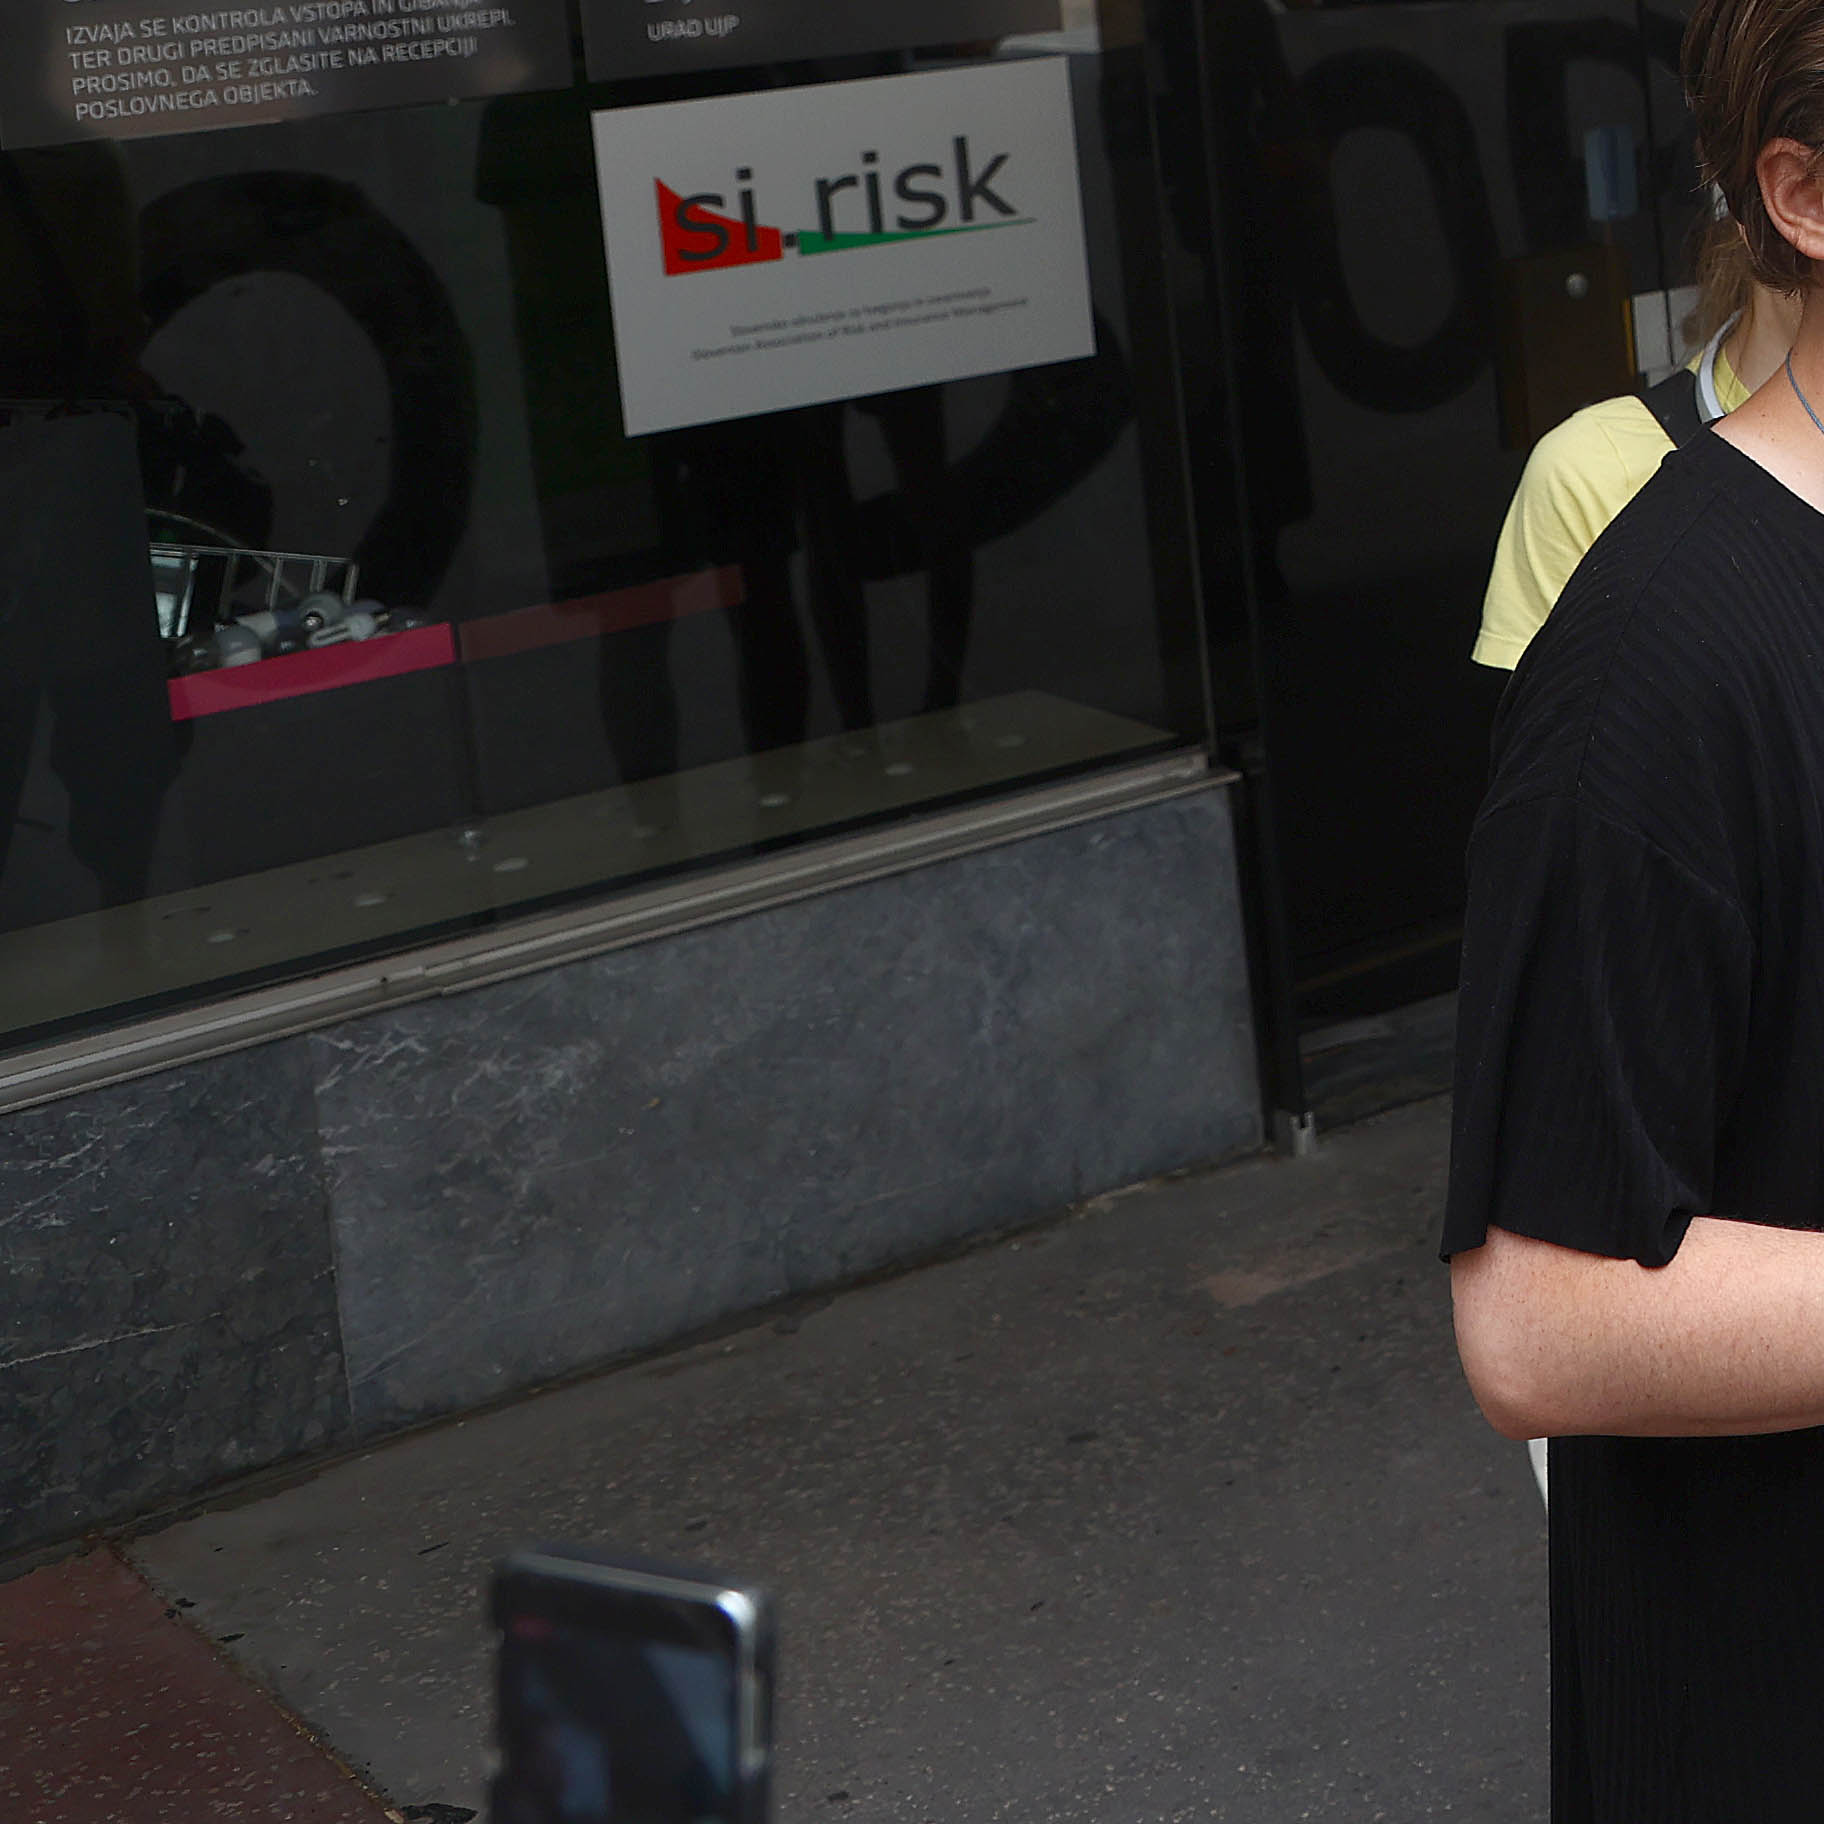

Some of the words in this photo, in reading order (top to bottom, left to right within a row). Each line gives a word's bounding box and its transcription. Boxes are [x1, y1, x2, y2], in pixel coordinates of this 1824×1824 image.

[66, 21, 136, 46] IZVAJA
[140, 18, 168, 39] SE
[172, 6, 286, 36] KONTROLA
[70, 49, 112, 71] TER
[117, 41, 183, 66] DRUGI
[190, 27, 316, 58] PREDPISANI
[318, 16, 433, 46] VARNOSTNI
[647, 17, 702, 43] URAD
[181, 64, 212, 86] DA
[215, 60, 242, 82] SE
[248, 49, 344, 78] ZGLASITE
[349, 46, 380, 68] NA
[76, 87, 219, 122] POSLOVNEGA
